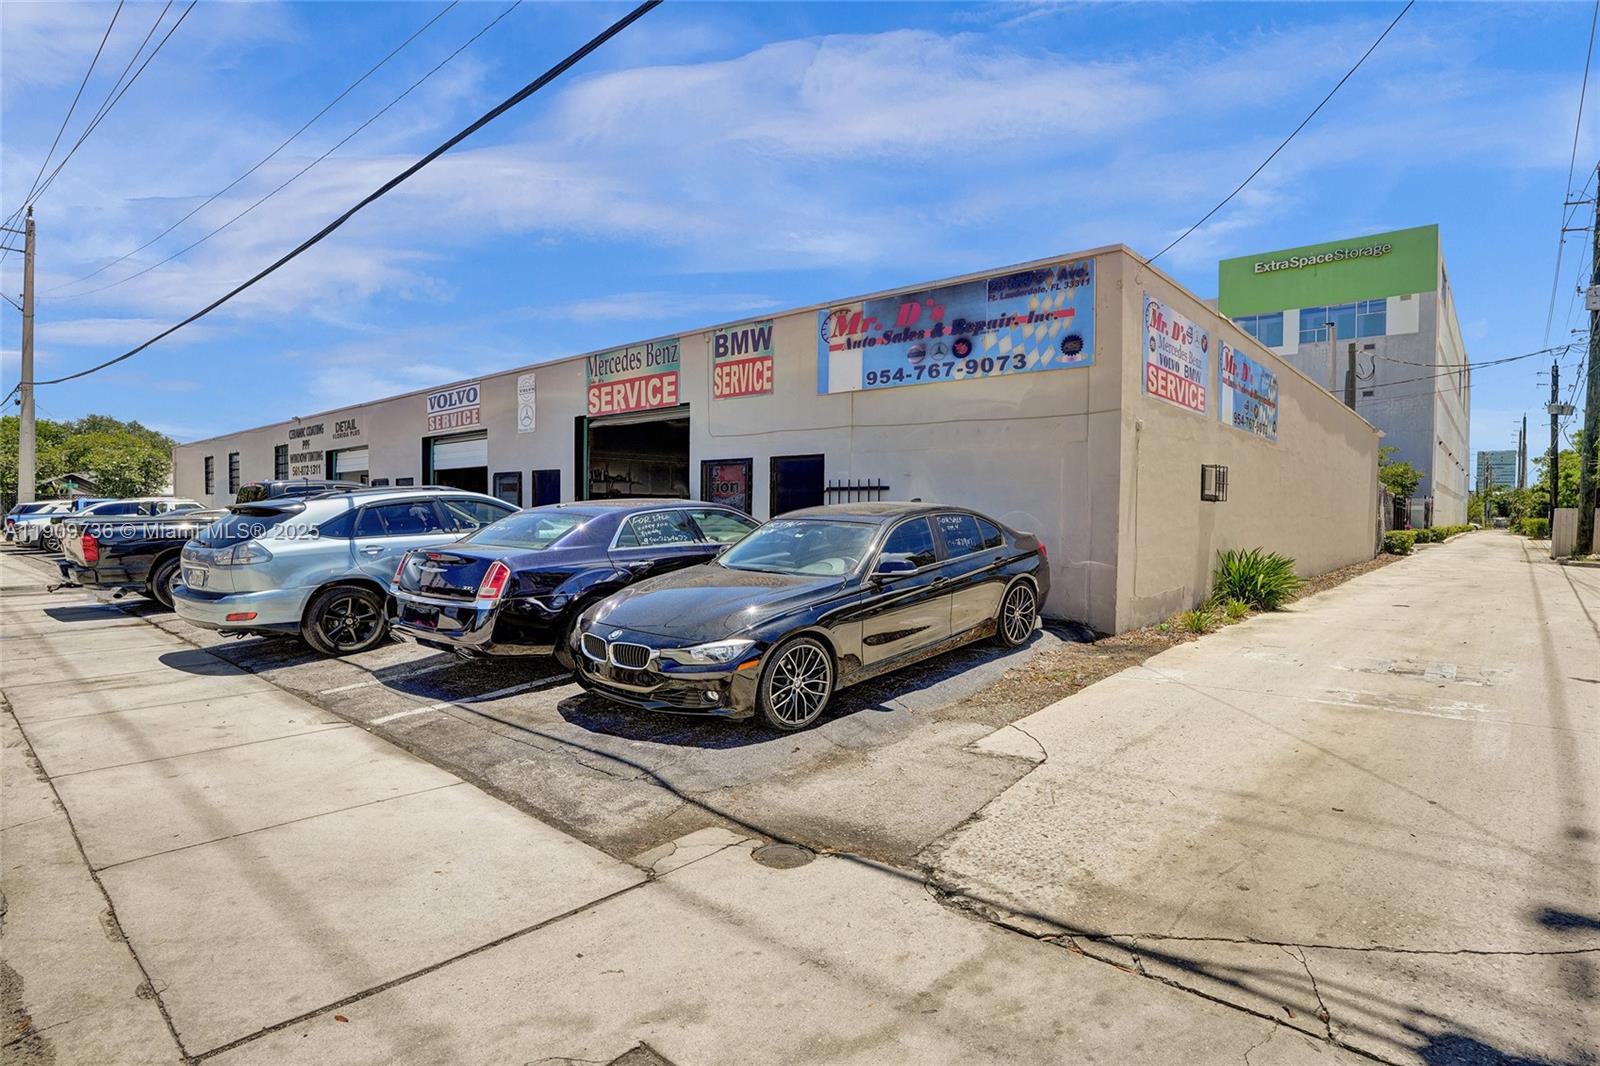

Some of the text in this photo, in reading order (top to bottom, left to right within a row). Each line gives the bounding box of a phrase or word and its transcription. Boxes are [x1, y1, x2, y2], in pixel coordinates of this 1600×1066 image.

[1254, 243, 1392, 274] ExtraSpaceStorage
[1050, 282, 1061, 292] FL
[830, 299, 946, 338] Mr. D's
[1150, 308, 1169, 337] Mr.
[715, 325, 773, 358] BMW
[842, 337, 877, 351] Auto
[881, 328, 926, 346] Sales
[588, 343, 679, 378] Mercedes Benz
[866, 353, 1027, 386] 954-767-9073
[1159, 353, 1180, 374] VOLVO
[714, 360, 772, 396] SERVICE
[1147, 365, 1206, 410] SERVICE
[428, 387, 478, 410] VOLVO
[589, 375, 677, 414] SERVICE
[335, 419, 357, 433] DETAIL
[429, 409, 479, 431] SERVICE
